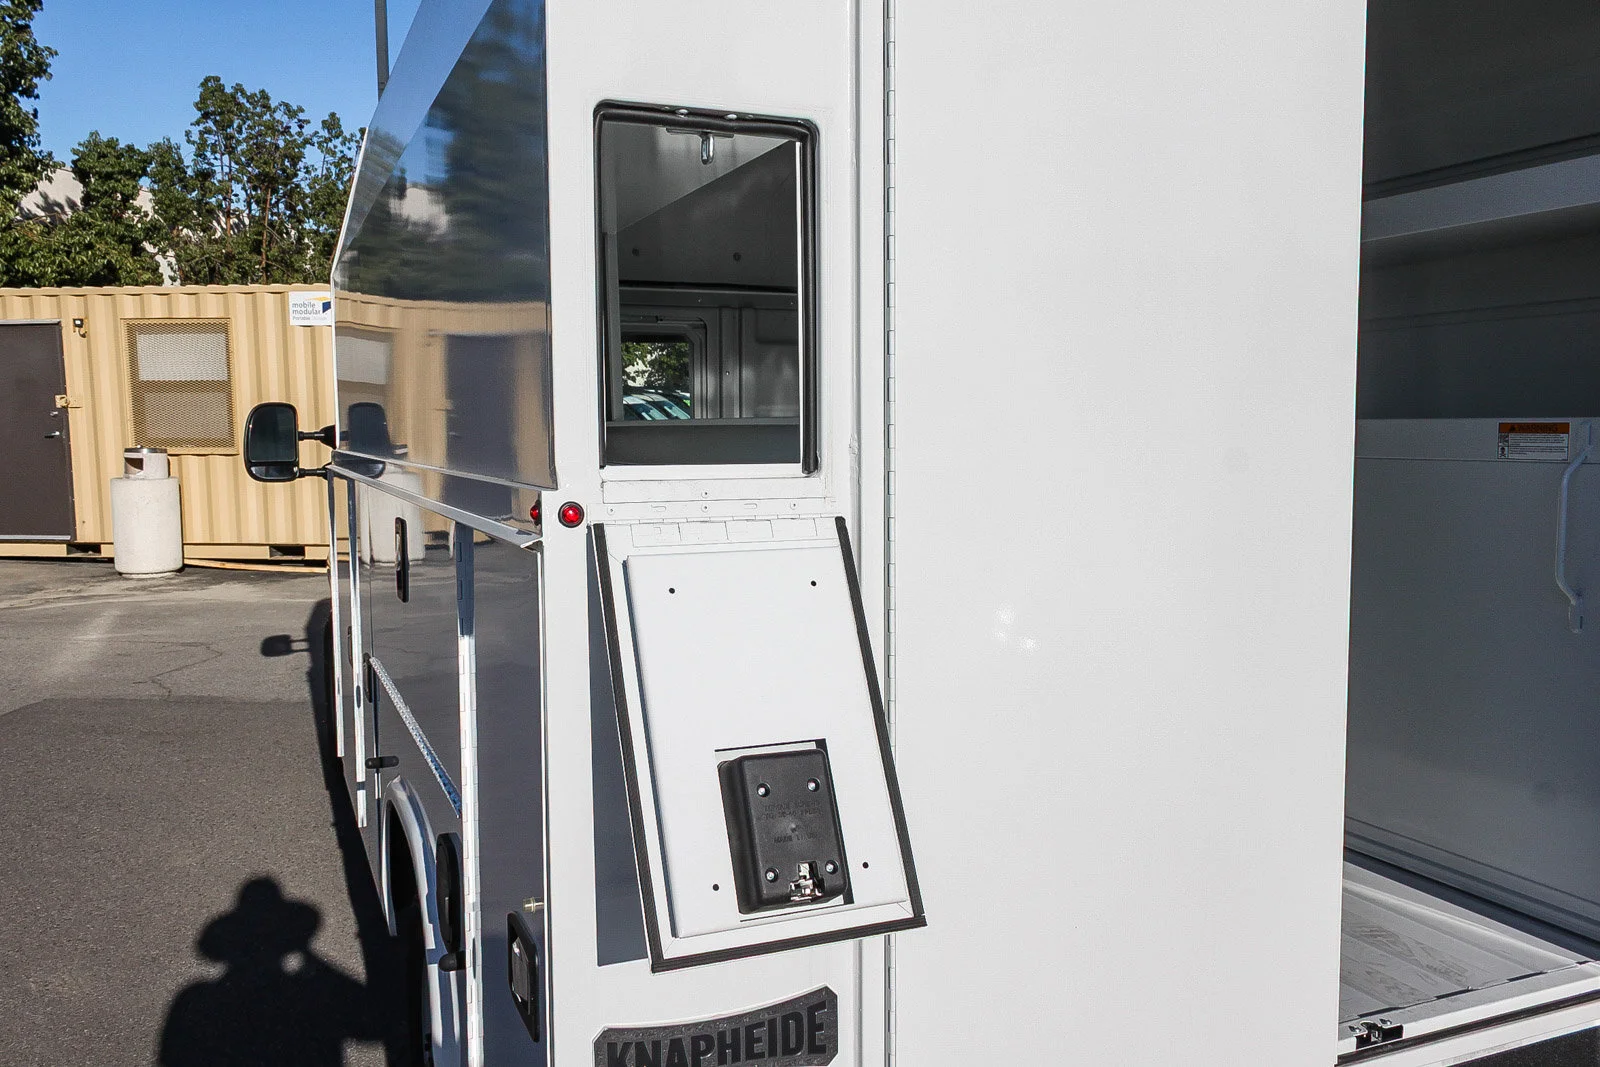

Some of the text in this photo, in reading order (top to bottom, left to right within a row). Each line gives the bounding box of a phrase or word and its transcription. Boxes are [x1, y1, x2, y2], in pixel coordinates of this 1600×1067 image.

[292, 301, 316, 309] mobile
[1517, 424, 1559, 433] WARNING
[606, 1000, 828, 1067] KNAPHEIDE
